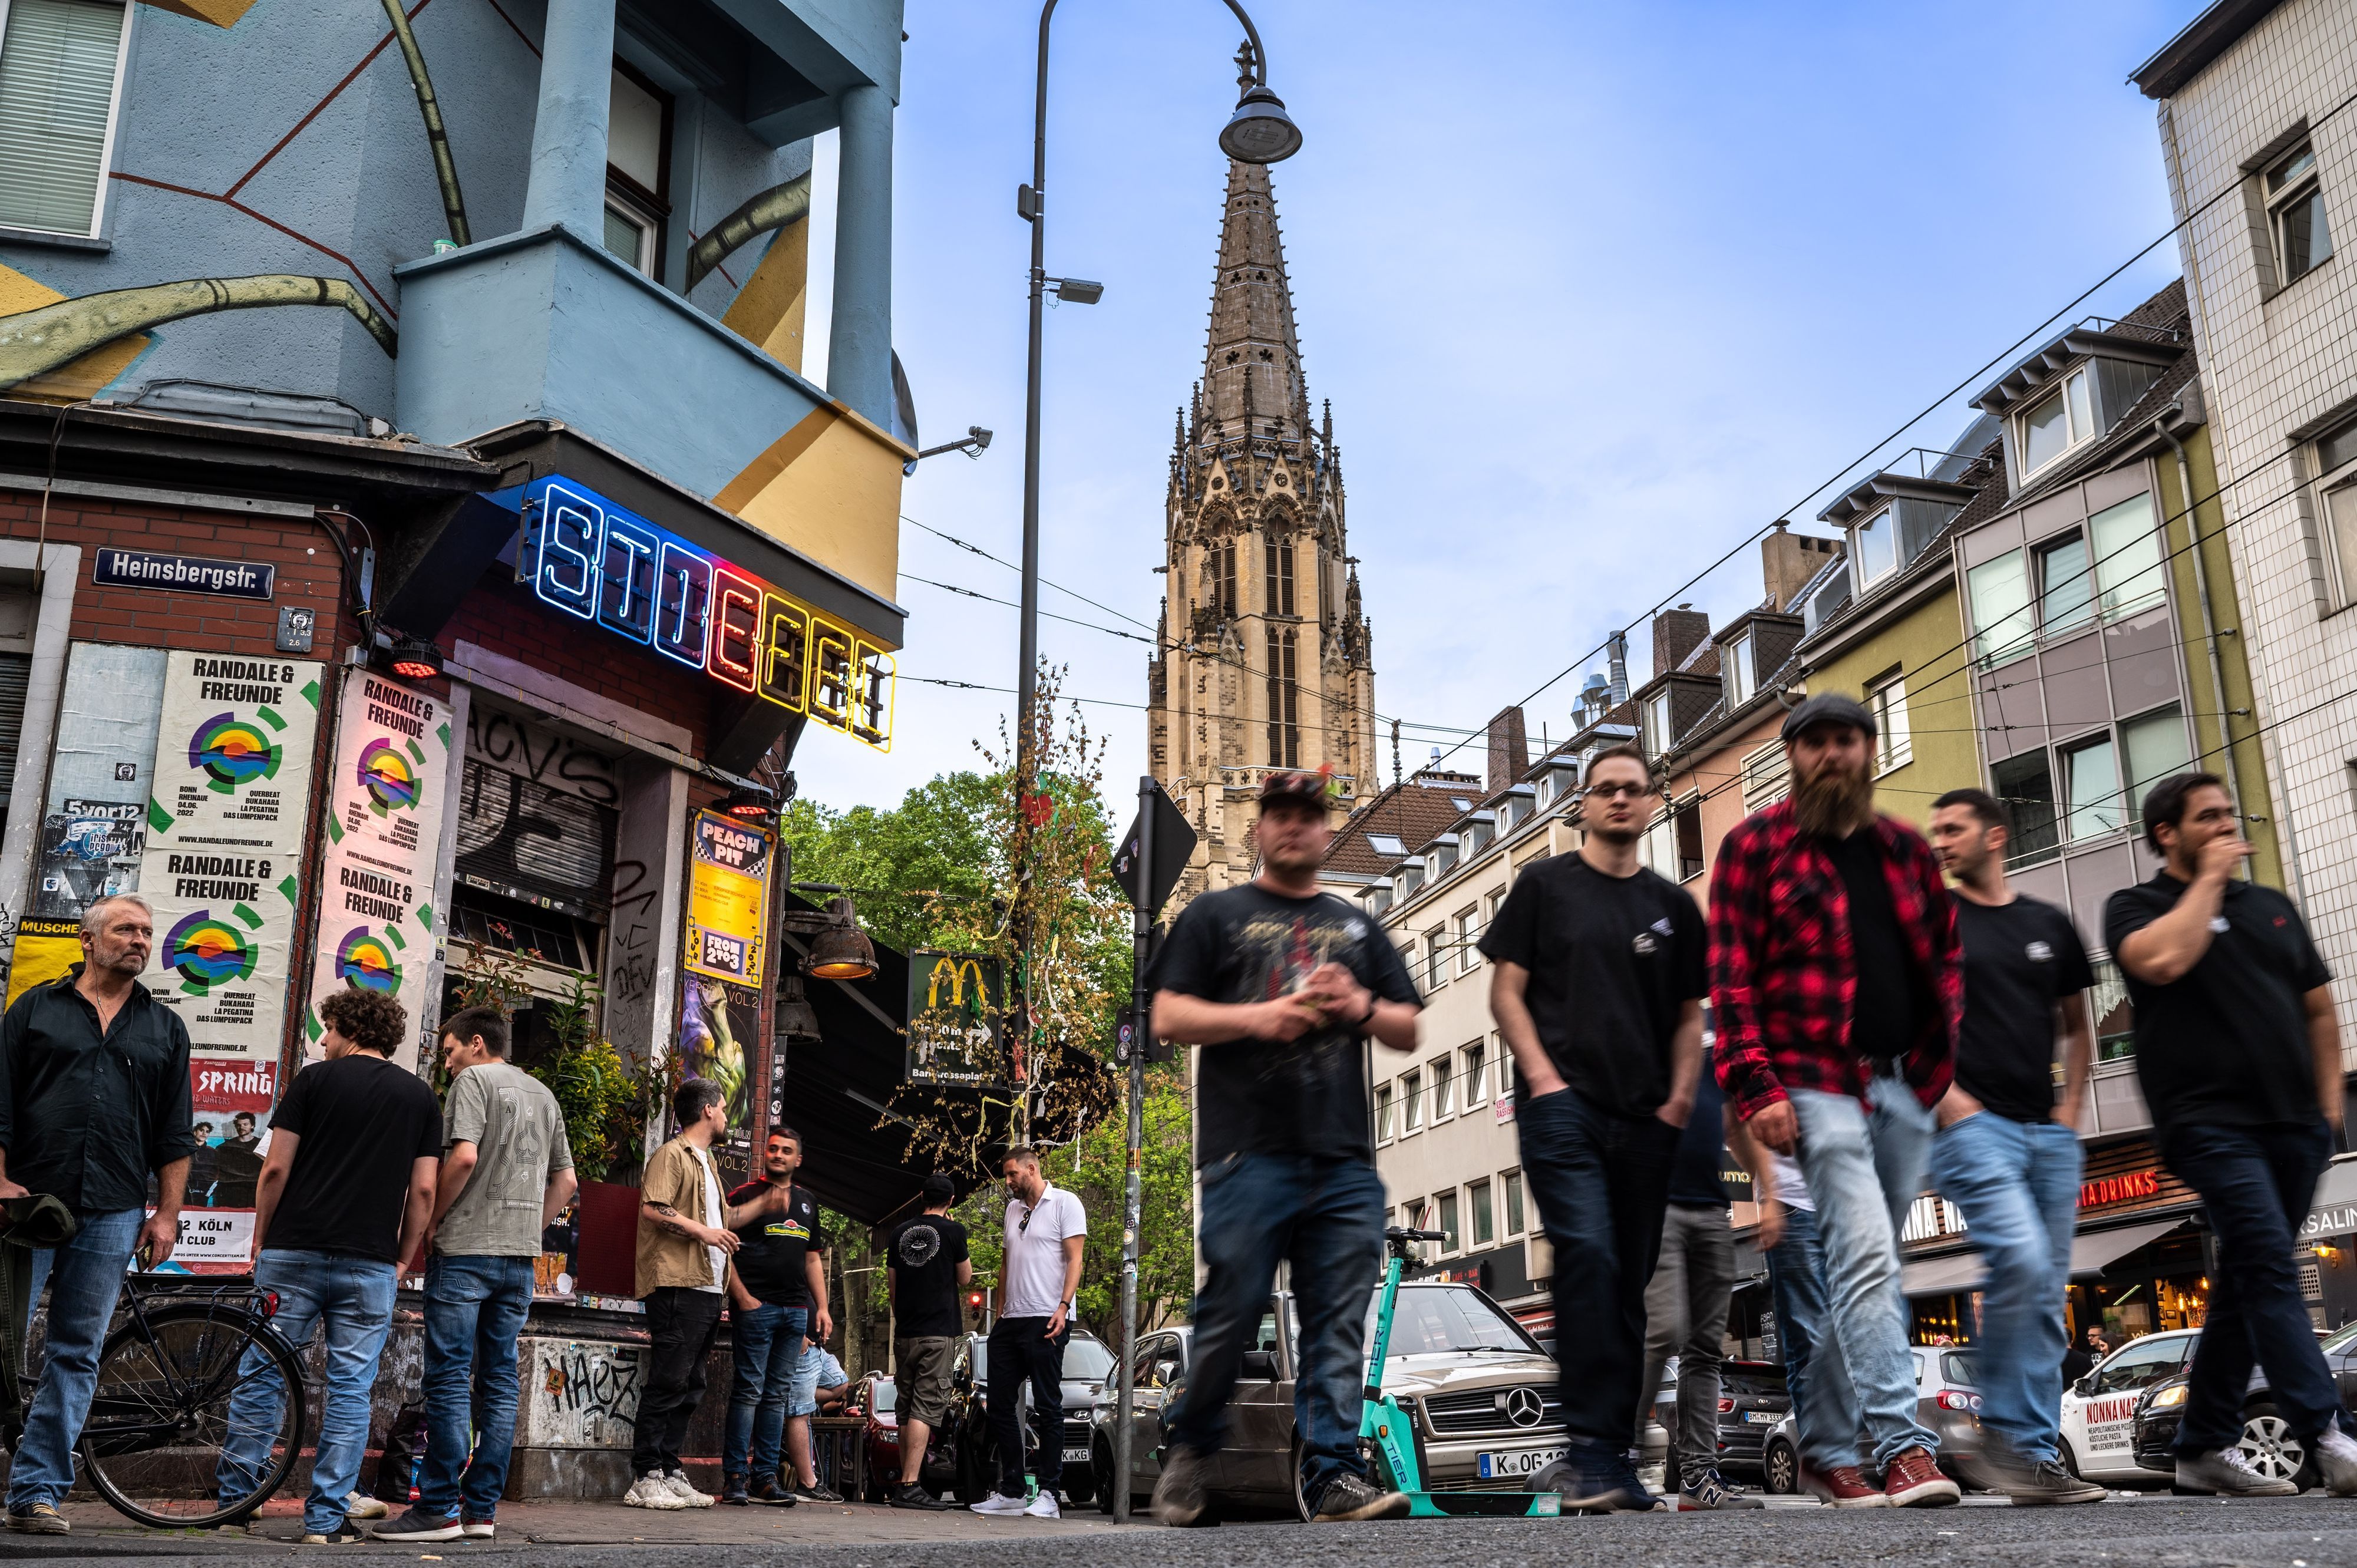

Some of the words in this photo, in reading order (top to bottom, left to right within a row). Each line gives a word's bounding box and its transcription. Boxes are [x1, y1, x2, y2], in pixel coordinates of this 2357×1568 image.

[111, 553, 256, 590] Heinsbergstr.
[193, 658, 278, 682] RANDALE
[280, 665, 294, 684] &
[200, 681, 283, 705] FREUNDE
[364, 678, 423, 718] RANDALE
[422, 703, 433, 722] &
[367, 702, 424, 740] FREUNDE
[349, 801, 362, 810] BONN
[237, 813, 278, 821] LUMPENPACK
[348, 809, 369, 821] RHEINAUE
[348, 817, 361, 826] 04.06.
[346, 824, 358, 833] 2022
[397, 817, 420, 829] QUERBEAT
[394, 824, 418, 837] BUKAHARA
[178, 836, 273, 847] WWW.RANDALEUNDFREUNDE.DE
[388, 837, 417, 851] LUMPENPACK
[397, 832, 417, 844] PEGATINA
[702, 822, 760, 853] PEACH
[715, 843, 743, 866] PIT
[167, 854, 255, 878] RANDALE
[258, 860, 272, 879] &
[346, 850, 412, 876] WWW.RANDALEUNDFREUNDE.DE
[175, 878, 259, 901] FREUNDE
[340, 867, 401, 901] RANDALE
[402, 885, 412, 904] &
[345, 892, 404, 924] FREUNDE
[21, 921, 80, 934] MUSCHE
[707, 935, 740, 955] FROM
[745, 946, 757, 975] 2022
[224, 992, 256, 1000] QUERBEAT
[739, 986, 758, 995] DIFFERENCE
[210, 1016, 253, 1024] LUMPENPACK
[197, 1071, 272, 1095] SPRING
[1496, 1105, 1515, 1118] RASSISM
[734, 1127, 751, 1140] KÖLN
[728, 1150, 748, 1158] DIFFERENCE
[2099, 1171, 2157, 1203] DRINKS
[199, 1219, 232, 1232] KÖLN
[187, 1236, 216, 1245] CLUB
[1468, 1268, 1478, 1279] BAR
[1367, 1329, 1384, 1381] TIER
[2087, 1400, 2118, 1424] NONNA
[2088, 1424, 2121, 1434] NEAPOLITANISCHE
[2089, 1434, 2108, 1442] KÖSTLICHE
[2109, 1432, 2121, 1441] PASTA
[2098, 1442, 2114, 1451] LECKERE
[2115, 1441, 2129, 1449] DRINKS
[1075, 1450, 1087, 1460] KG
[1387, 1442, 1408, 1486] TIER
[1497, 1455, 1508, 1474] K
